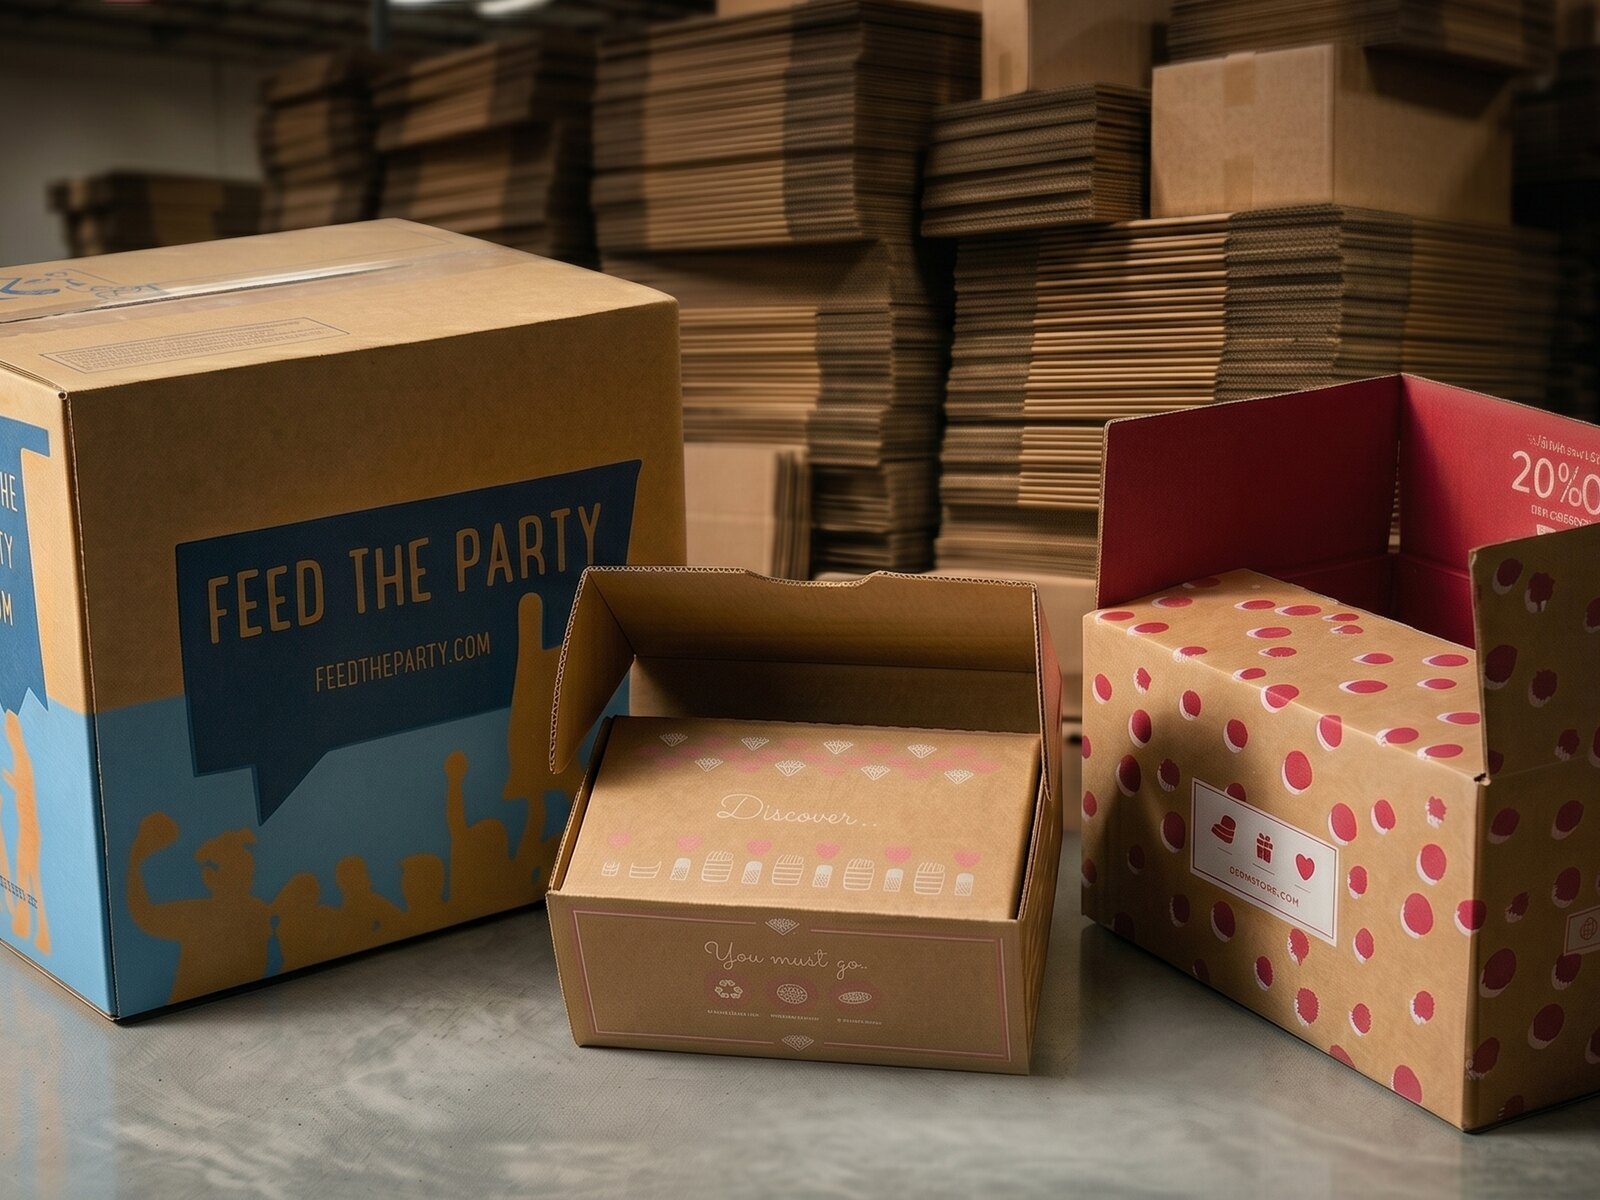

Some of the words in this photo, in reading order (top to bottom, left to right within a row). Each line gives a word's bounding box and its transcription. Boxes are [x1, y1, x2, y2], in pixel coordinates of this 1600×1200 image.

[0, 471, 18, 512] HE
[207, 559, 325, 644] FEED
[349, 537, 431, 614] THE
[455, 502, 601, 592] PARTY
[315, 632, 491, 692] FEEDTHEPARTY.COM
[704, 940, 764, 970] You
[770, 949, 829, 968] must
